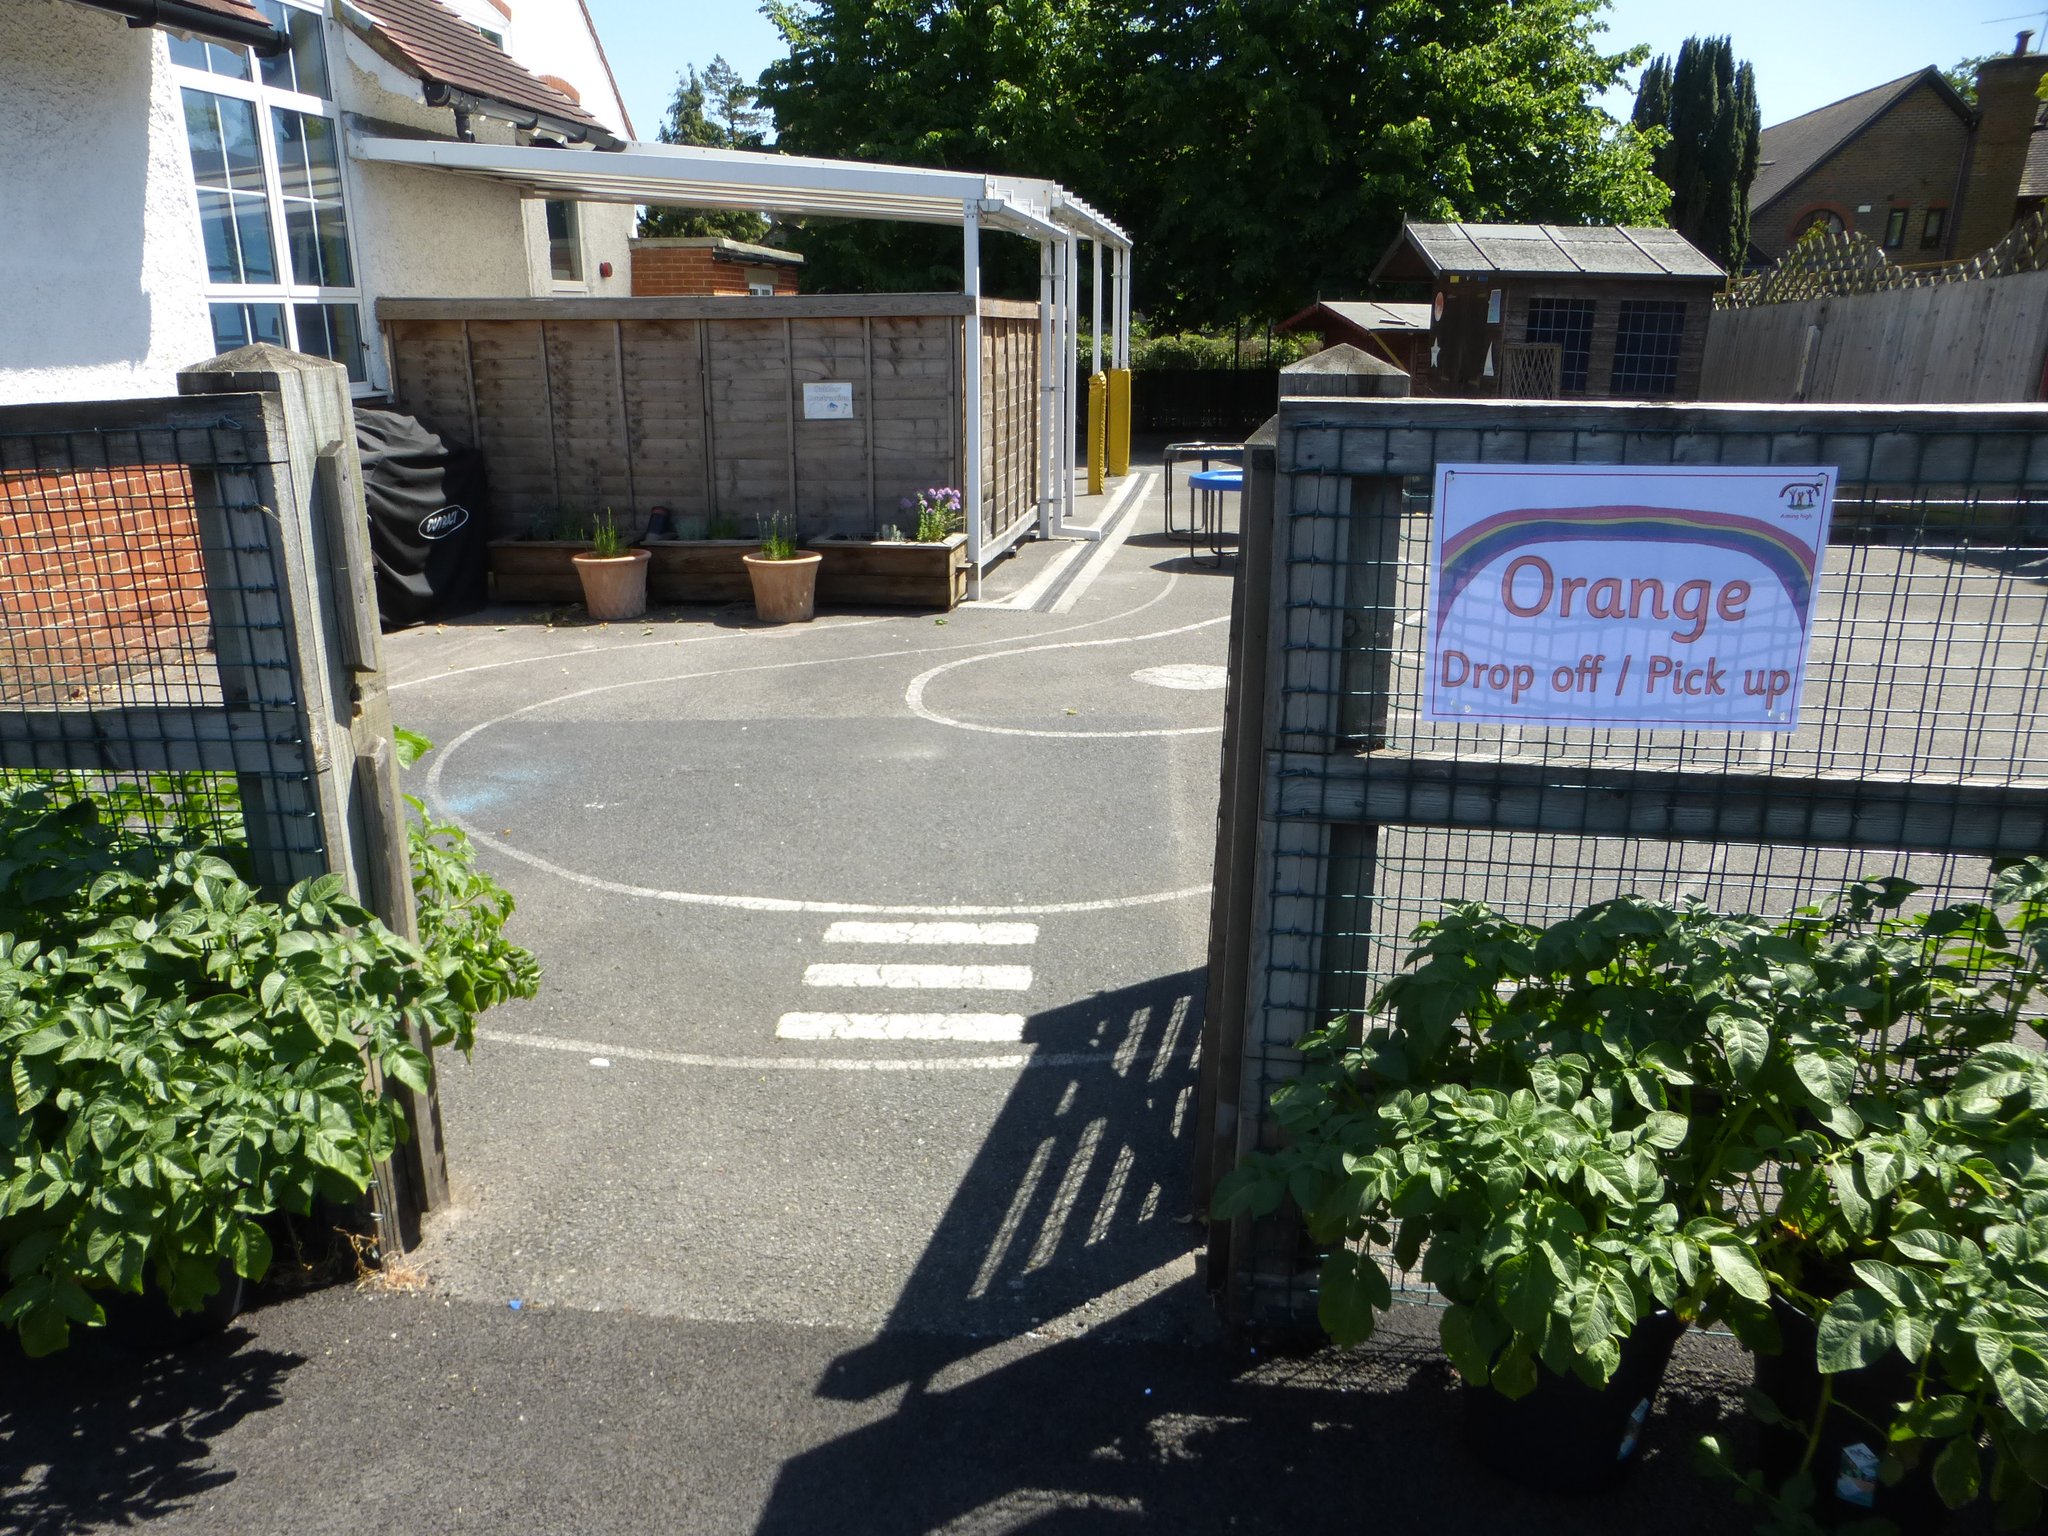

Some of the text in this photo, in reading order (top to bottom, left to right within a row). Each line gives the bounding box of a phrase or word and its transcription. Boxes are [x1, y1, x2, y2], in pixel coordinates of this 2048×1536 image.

[1501, 555, 1751, 644] Orange
[1441, 650, 1790, 710] Drop off / Pick up
